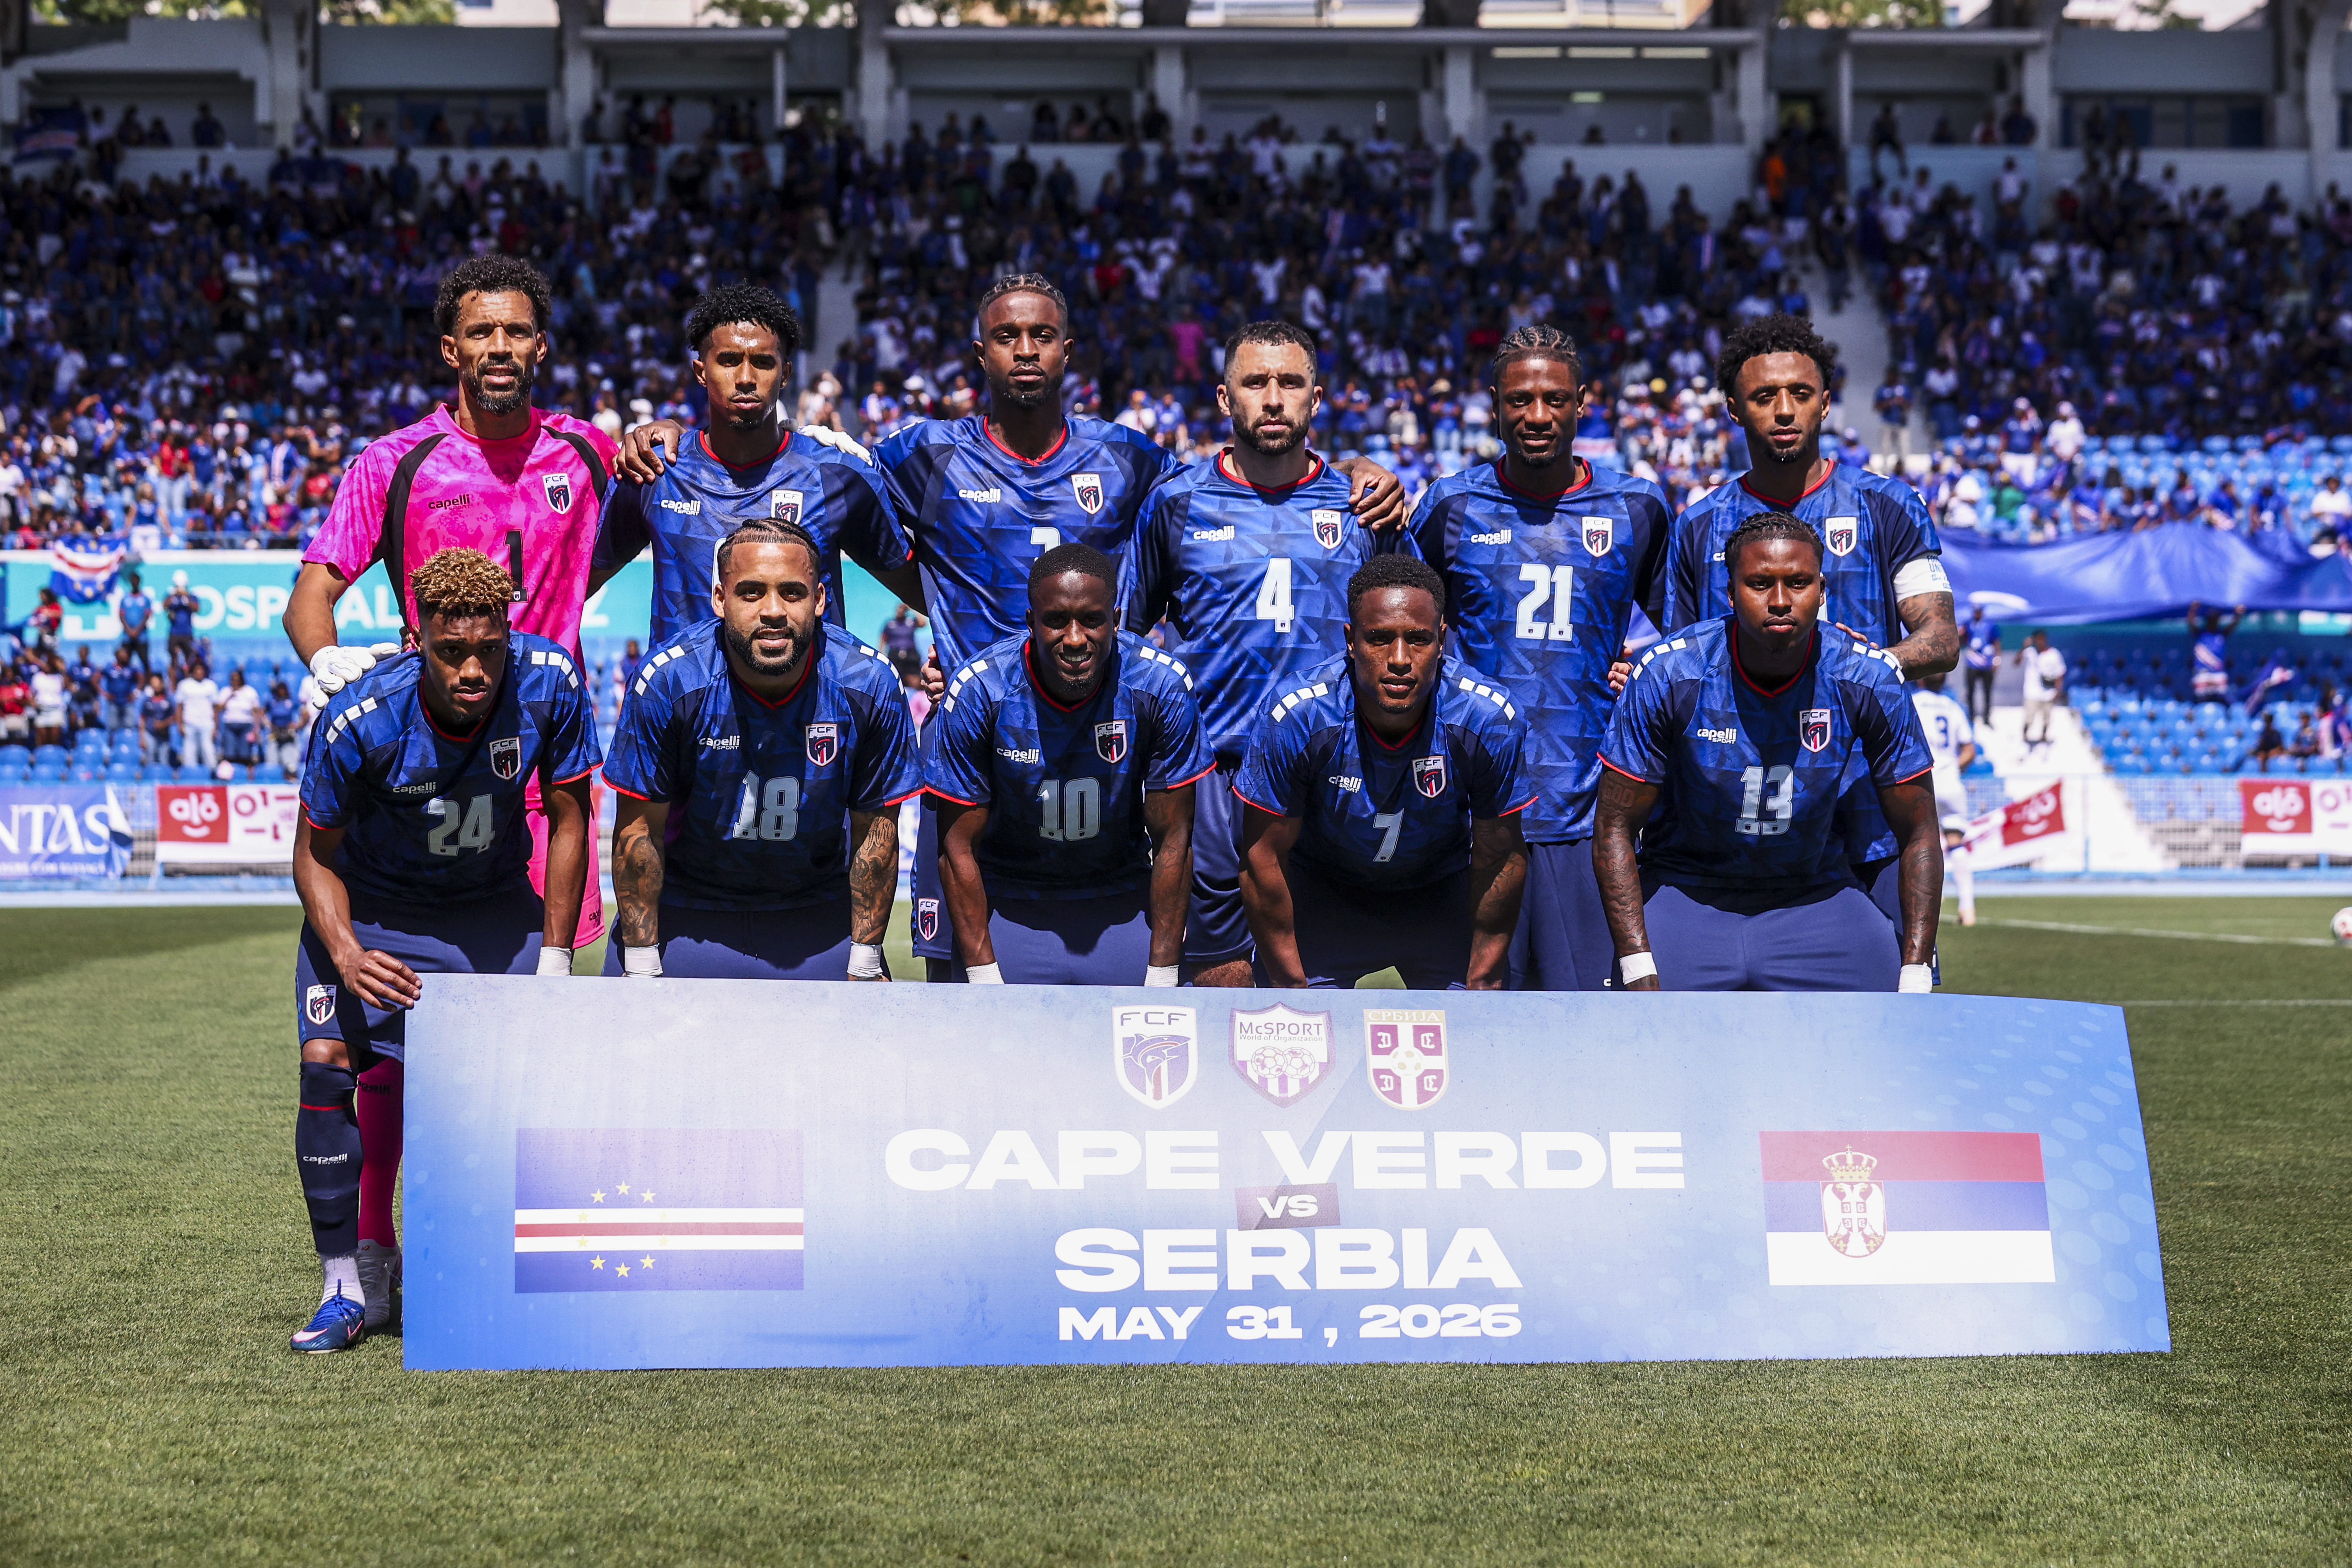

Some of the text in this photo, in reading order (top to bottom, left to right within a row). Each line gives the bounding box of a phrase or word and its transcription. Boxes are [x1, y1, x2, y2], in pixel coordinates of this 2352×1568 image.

[545, 475, 566, 484] FCF
[428, 494, 470, 510] capelli
[958, 488, 1001, 502] capelli
[661, 499, 701, 513] capelli
[1193, 525, 1235, 540] capelli
[1470, 529, 1512, 544] capelli
[503, 529, 528, 603] 1
[1256, 558, 1294, 632] 4
[1515, 563, 1573, 641] 21
[143, 585, 402, 631] OSPAL
[1097, 723, 1122, 732] FCF
[1697, 728, 1737, 740] capelli
[492, 739, 518, 750] FCF
[699, 735, 740, 749] capelli
[996, 747, 1040, 762] capelli
[1415, 759, 1441, 768] FCF
[392, 782, 437, 794] capelli
[1328, 775, 1363, 790] cpelli
[732, 769, 799, 841] 18
[1735, 764, 1794, 835] 13
[1037, 777, 1101, 842] 10
[428, 794, 495, 856] 24
[1373, 808, 1404, 862] 7
[310, 986, 335, 994] FCF
[1120, 1011, 1187, 1026] FCF
[1368, 1011, 1440, 1021] СРБИЈА
[1239, 1022, 1322, 1036] McSPORT
[303, 1153, 348, 1165] capelli
[885, 1129, 1685, 1191] CAPE VERDE
[1257, 1194, 1318, 1219] VS
[1055, 1228, 1523, 1292] SERBIA
[1059, 1306, 1204, 1340] MAY
[1226, 1305, 1302, 1339] 31
[1359, 1303, 1522, 1338] 2026
